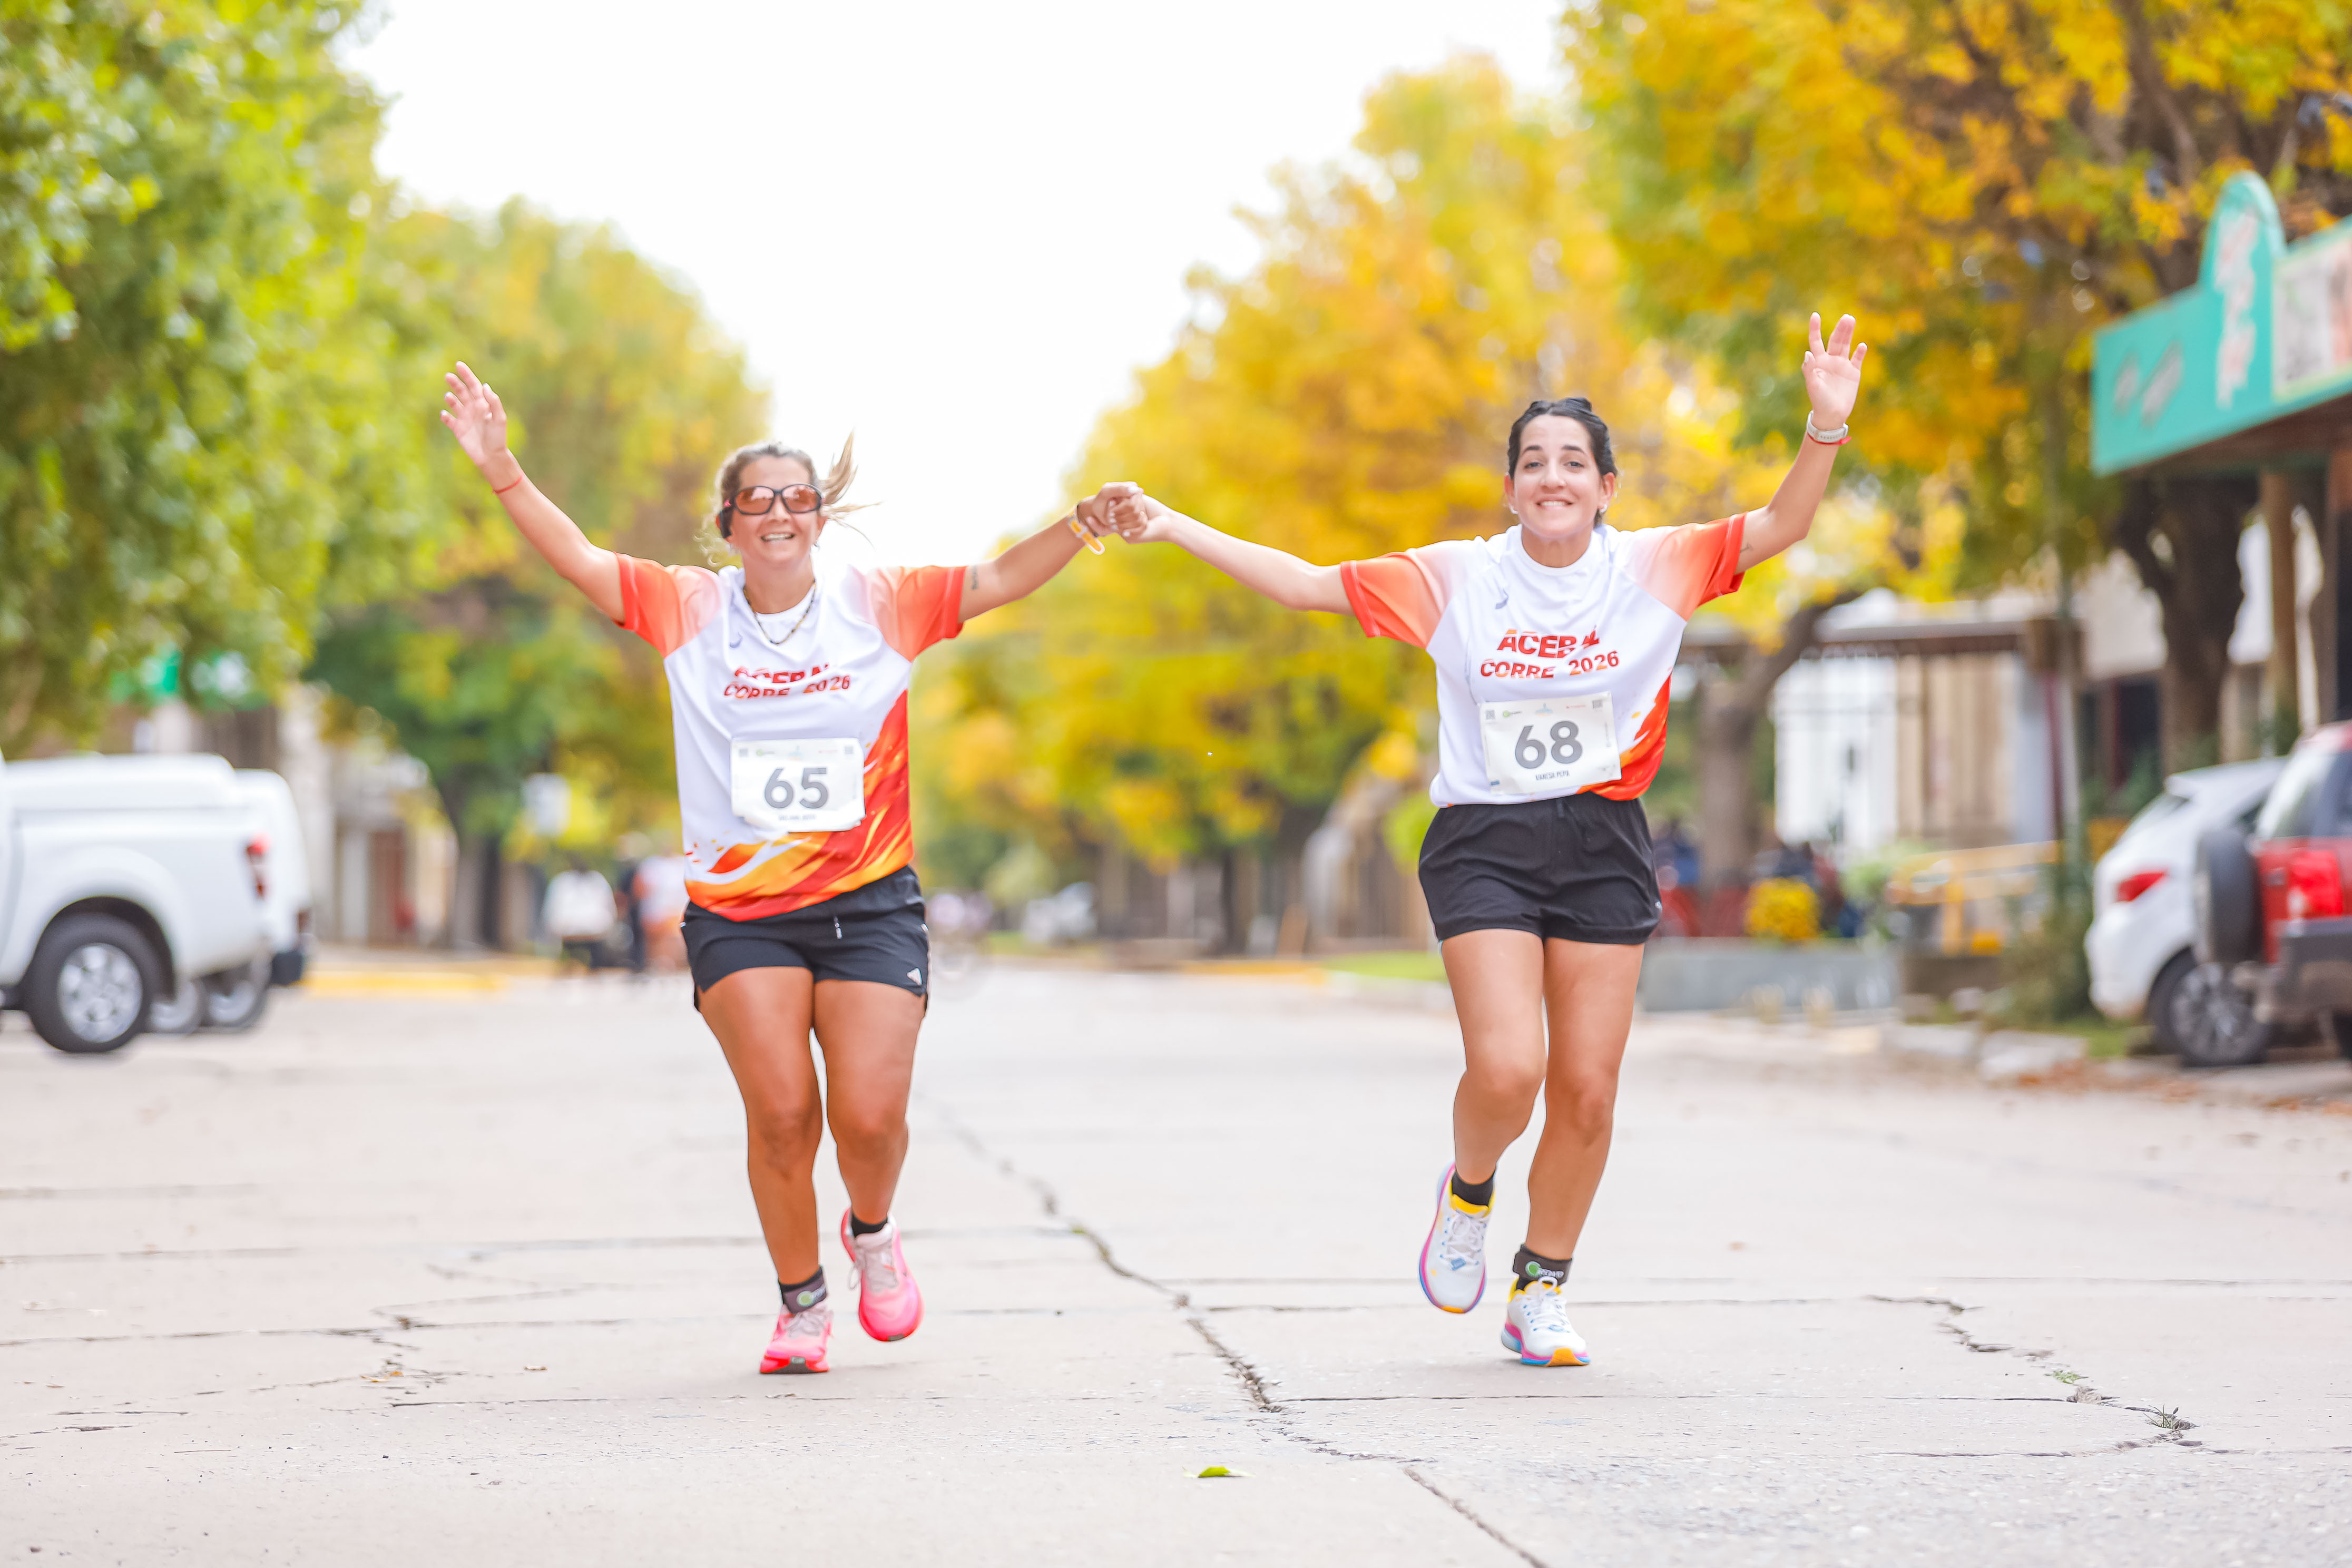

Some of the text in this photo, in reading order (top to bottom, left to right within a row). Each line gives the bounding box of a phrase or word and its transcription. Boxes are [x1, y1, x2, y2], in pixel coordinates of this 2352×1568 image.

[1481, 651, 1619, 678] CORRE 2026
[803, 675, 850, 693] 2026
[1515, 720, 1583, 769] 68
[765, 768, 828, 809] 65
